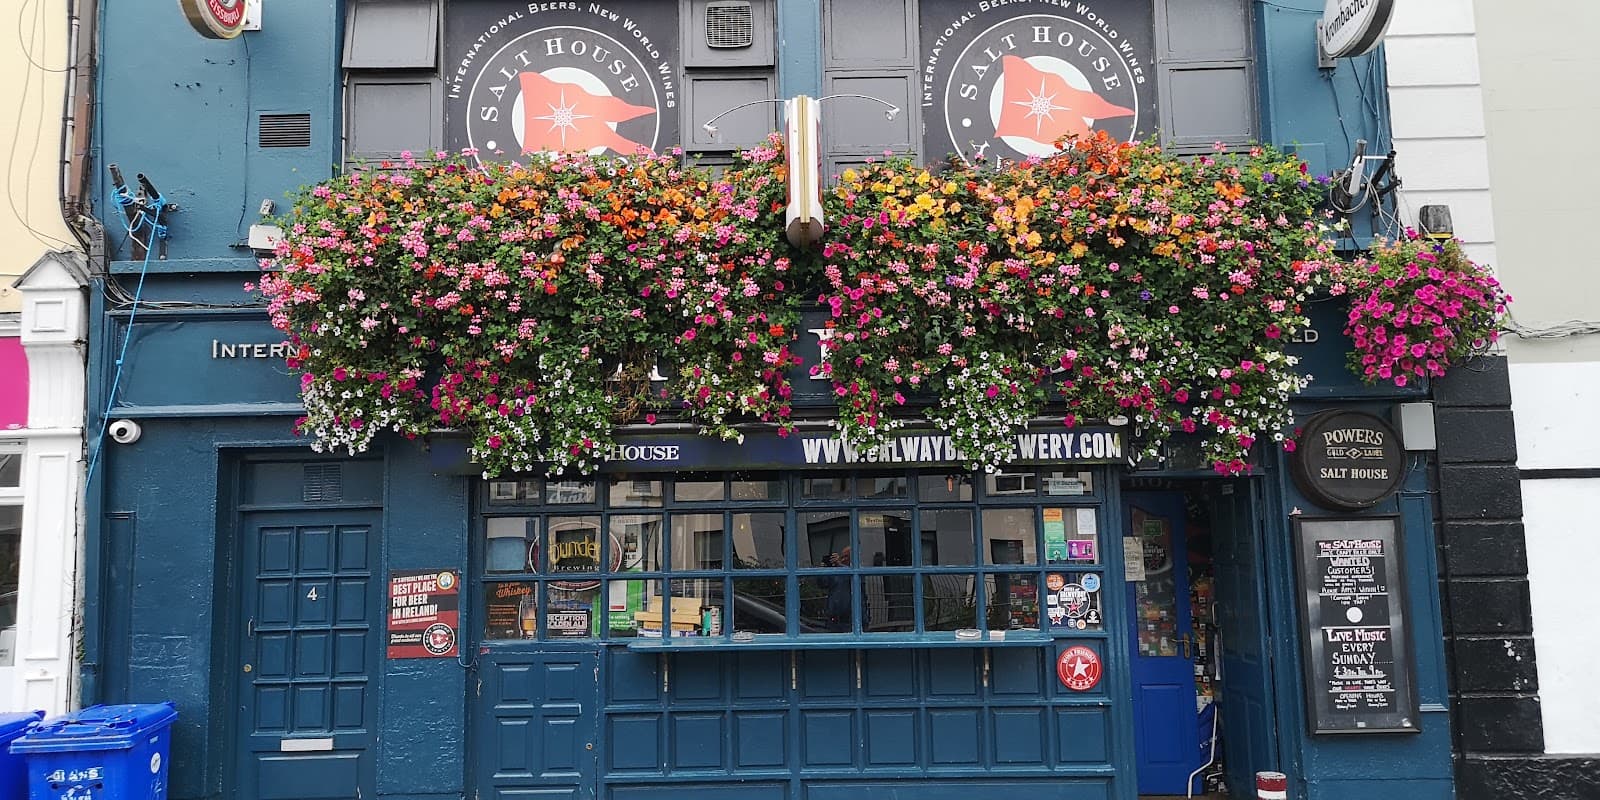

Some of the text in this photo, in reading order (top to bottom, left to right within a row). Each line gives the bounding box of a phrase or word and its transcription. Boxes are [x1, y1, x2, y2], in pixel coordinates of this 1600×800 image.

[1325, 0, 1368, 44] Krombacher
[448, 2, 675, 108] INTERNATIONAL BEERS, NEW WORLD WINES
[922, 11, 976, 107] INTERNATIONAL
[1075, 3, 1118, 39] WORLD
[1119, 39, 1145, 84] WINES
[960, 26, 1121, 100] SALT HOUSE
[480, 37, 639, 122] SALT HOUSE
[1323, 429, 1384, 446] POWERS
[609, 445, 679, 461] HOUSE
[803, 433, 1122, 464] WWW.ALWAYBEWERY.COM
[1364, 449, 1383, 457] LABEL
[1321, 468, 1388, 479] SALT HOUSE
[306, 586, 318, 601] 4
[393, 580, 437, 596] BEST PLACE
[392, 594, 427, 607] FOR BEER
[392, 604, 438, 619] IN IRELAND!
[1327, 629, 1386, 641] LIVE MUSIC
[1342, 642, 1375, 652] EVERY
